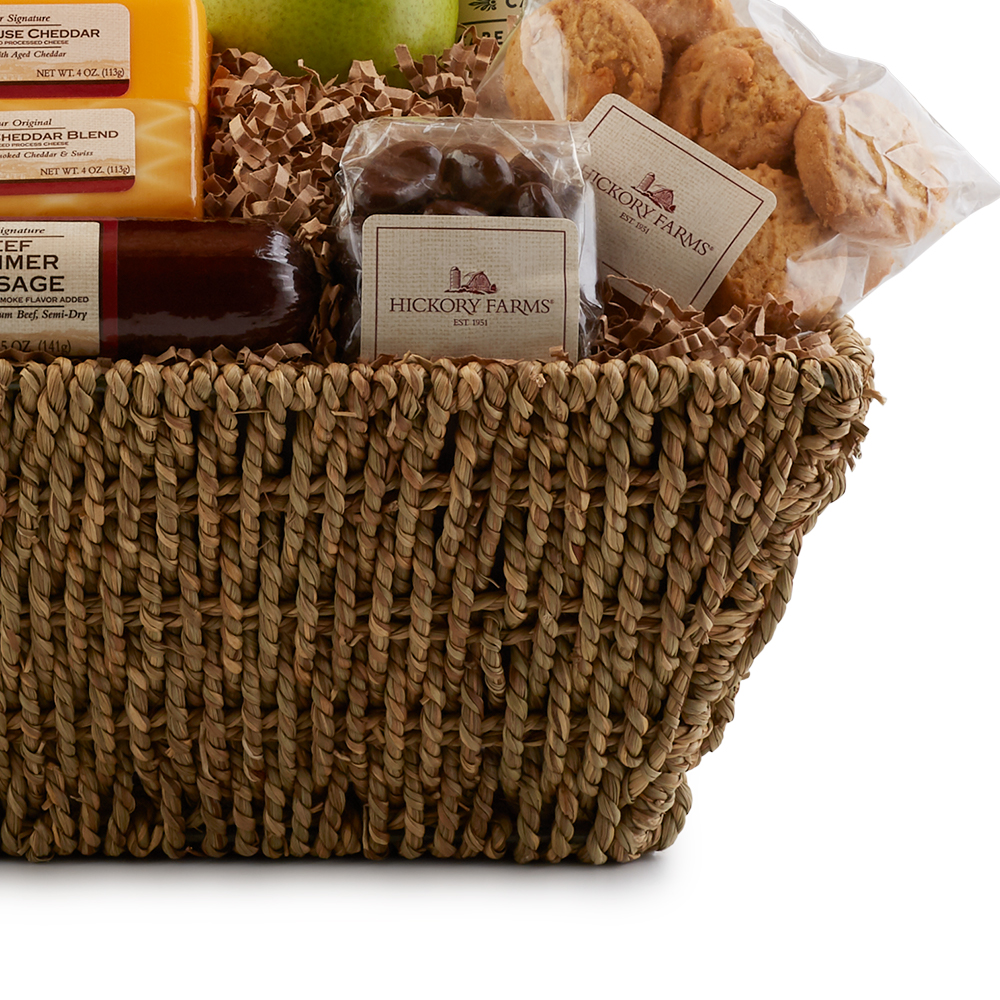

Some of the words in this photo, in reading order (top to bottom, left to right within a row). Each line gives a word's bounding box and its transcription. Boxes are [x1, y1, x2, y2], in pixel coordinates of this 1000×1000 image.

[7, 13, 51, 24] Signature
[27, 28, 101, 39] CHEDDAR
[11, 50, 31, 60] Aged
[33, 50, 67, 58] Cheddar
[36, 69, 56, 78] NET
[58, 68, 75, 77] WT.
[77, 68, 82, 77] 4
[83, 68, 100, 77] OZ.
[102, 67, 125, 79] (113g)
[12, 118, 52, 129] Original
[67, 130, 119, 140] BLEND
[24, 150, 57, 159] Cheddar
[60, 150, 67, 158] &
[71, 149, 94, 157] Swiss
[40, 167, 60, 176] NET
[62, 166, 79, 175] WT.
[81, 166, 86, 175] 4
[88, 166, 104, 175] OZ.
[106, 165, 131, 176] (113g)
[636, 222, 650, 235] 1951
[25, 296, 58, 304] FLAVOR
[389, 297, 482, 315] HICKORY
[16, 309, 38, 322] Beef,
[42, 309, 87, 321] Semi-Dry
[472, 319, 488, 327] 1951
[1, 340, 7, 353] 5
[37, 339, 72, 354] (141g)
